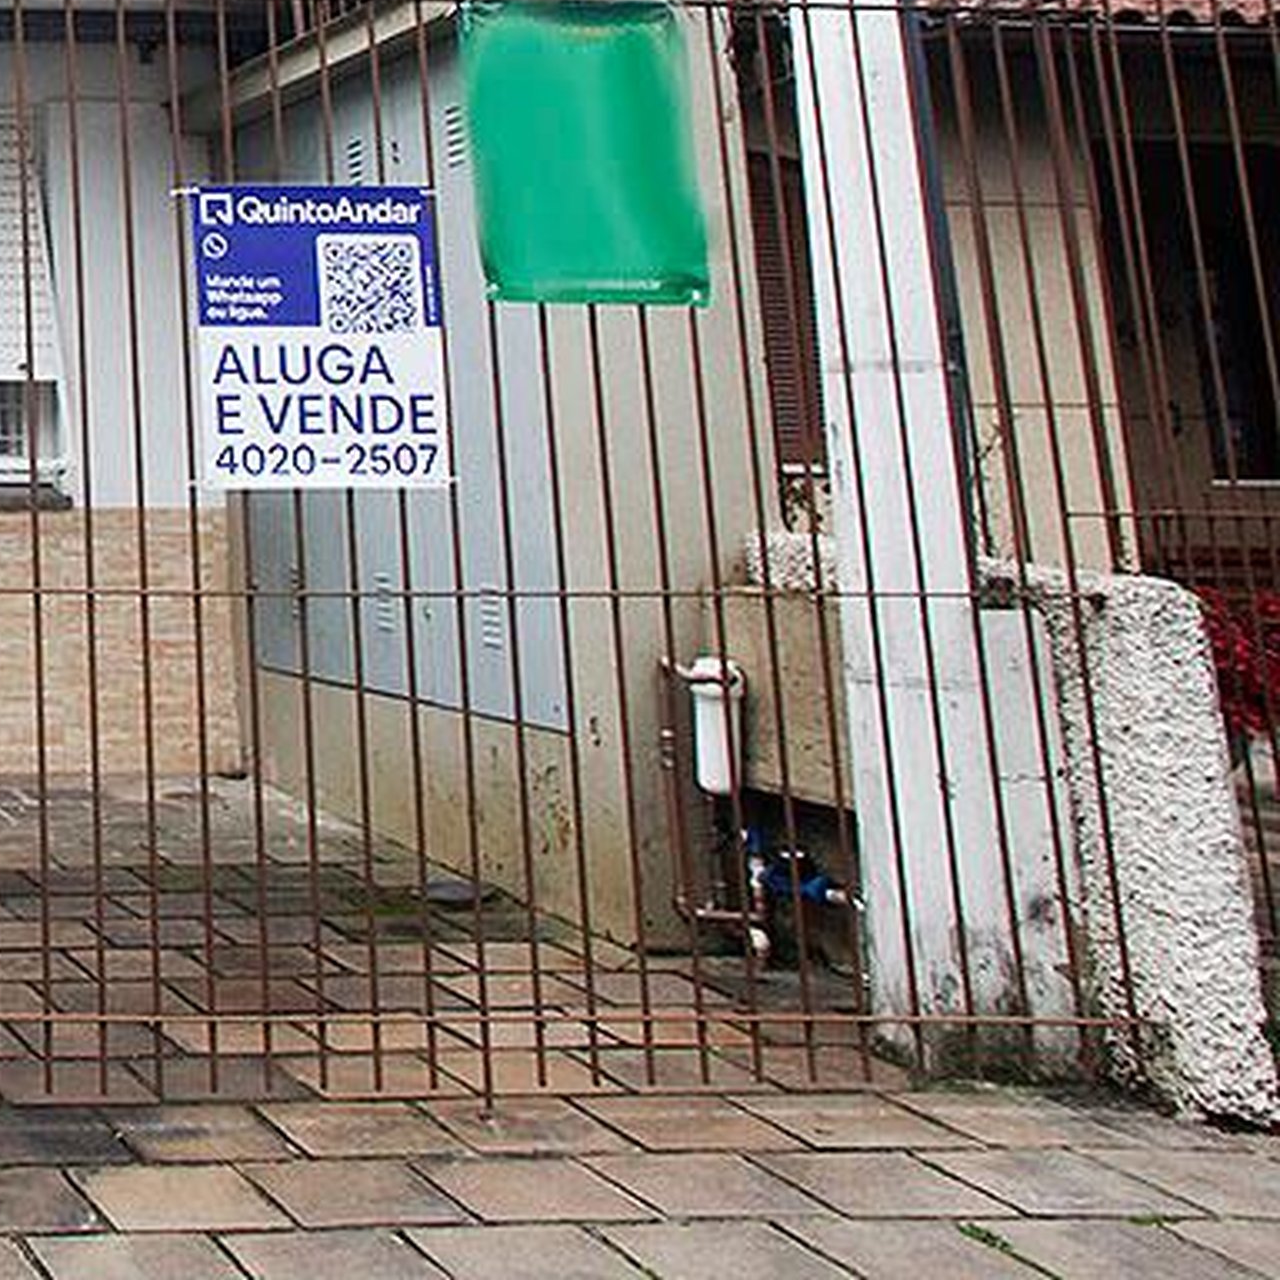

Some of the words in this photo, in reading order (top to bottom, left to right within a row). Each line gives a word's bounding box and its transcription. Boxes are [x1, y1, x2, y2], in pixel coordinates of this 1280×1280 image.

[236, 195, 421, 224] QuintoAndar
[212, 343, 394, 385] ALUGA
[215, 394, 245, 435] E
[258, 394, 438, 435] VENDE
[214, 442, 438, 476] 4020-2507
